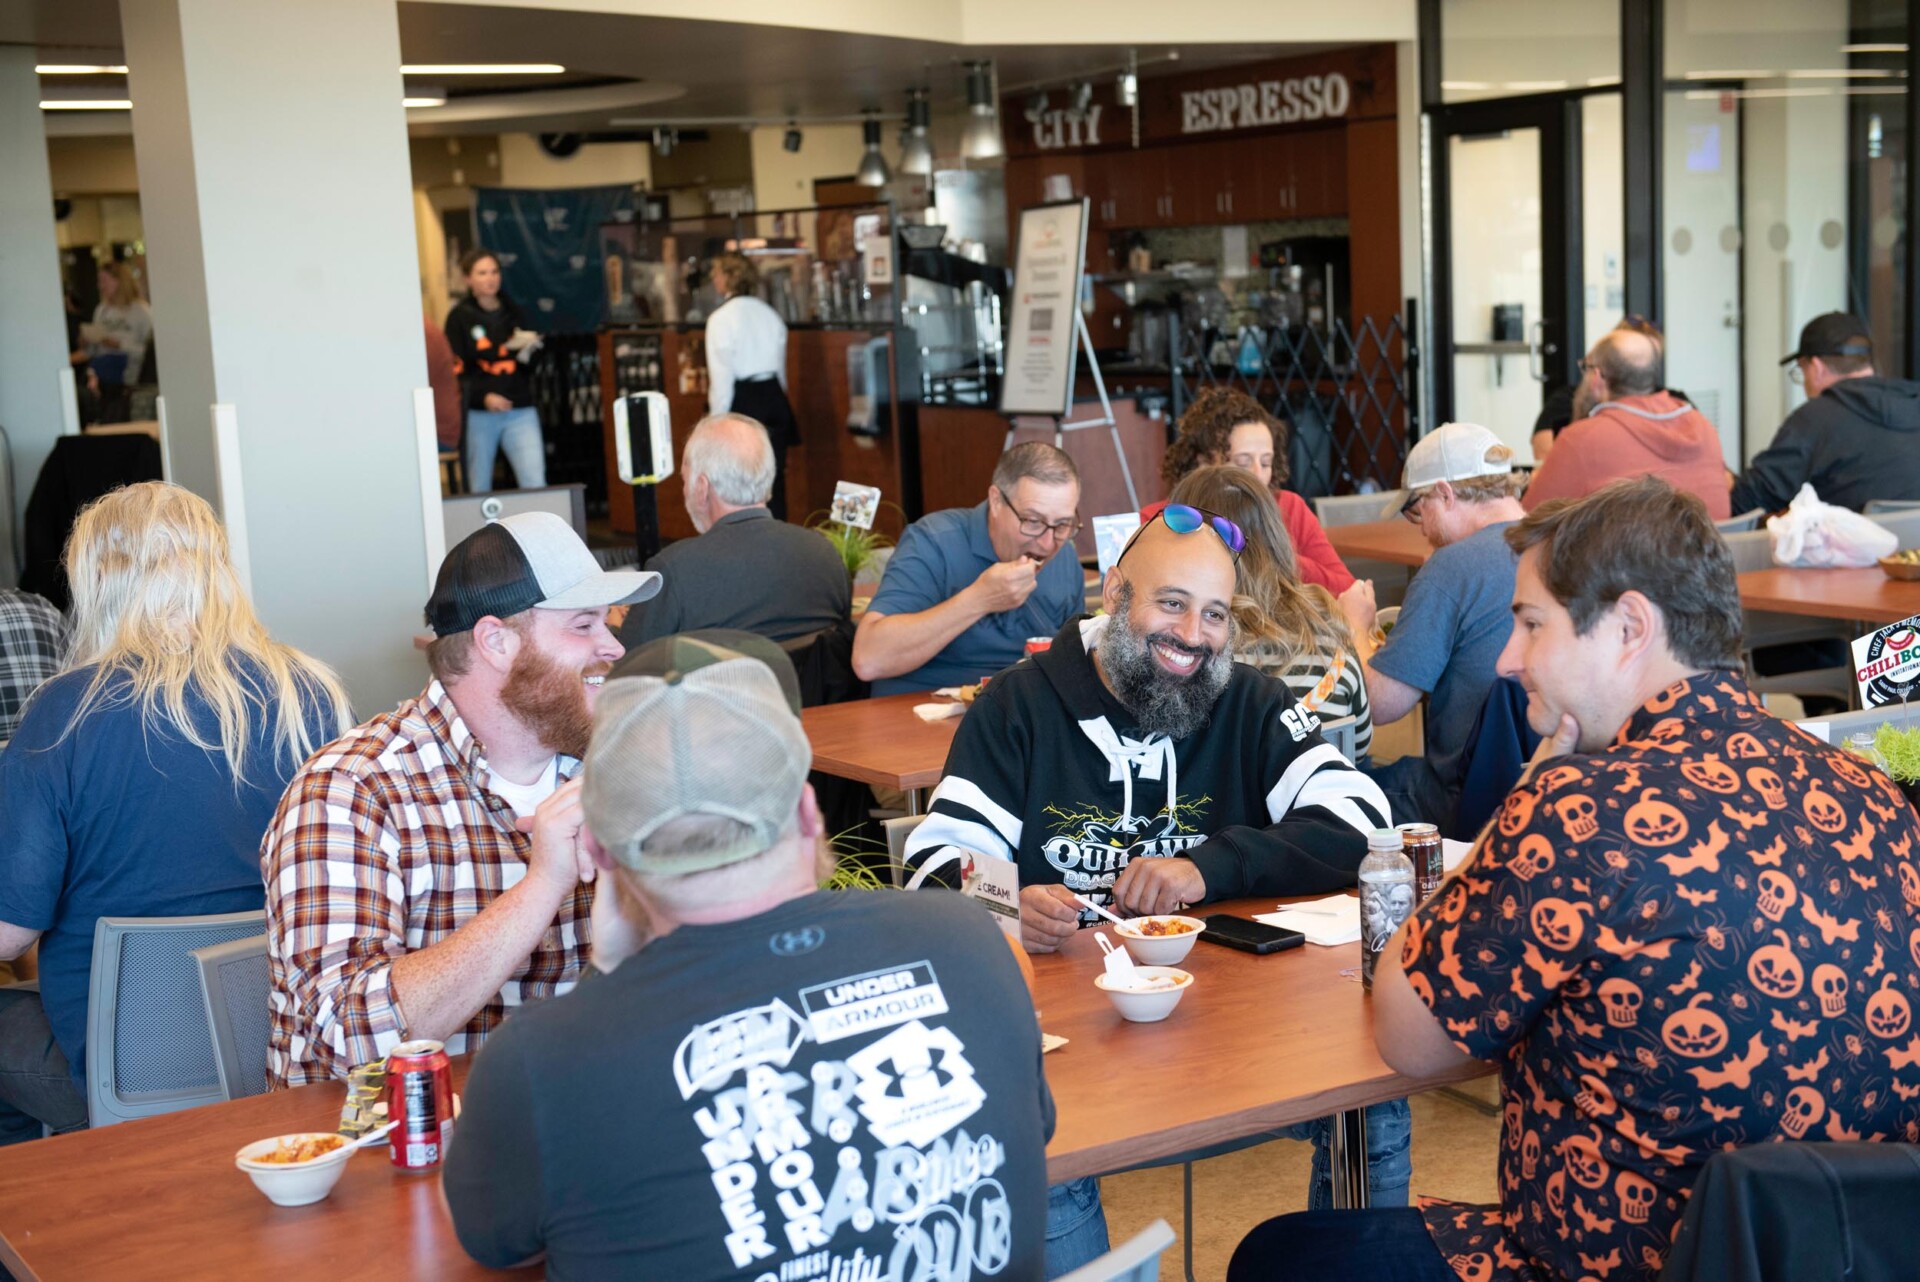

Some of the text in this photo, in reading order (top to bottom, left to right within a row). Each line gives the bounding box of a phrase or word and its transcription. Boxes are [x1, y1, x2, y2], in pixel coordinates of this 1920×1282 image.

[1033, 72, 1349, 149] CITY ESPRESSO
[1870, 637, 1883, 657] CHEF
[1879, 623, 1900, 639] JACKS
[1063, 868, 1116, 891] DRAG
[823, 970, 916, 1007] UNDER
[826, 992, 935, 1032] ARMOUR
[746, 1064, 833, 1256] ARMOUR
[692, 1095, 777, 1269] UNDER
